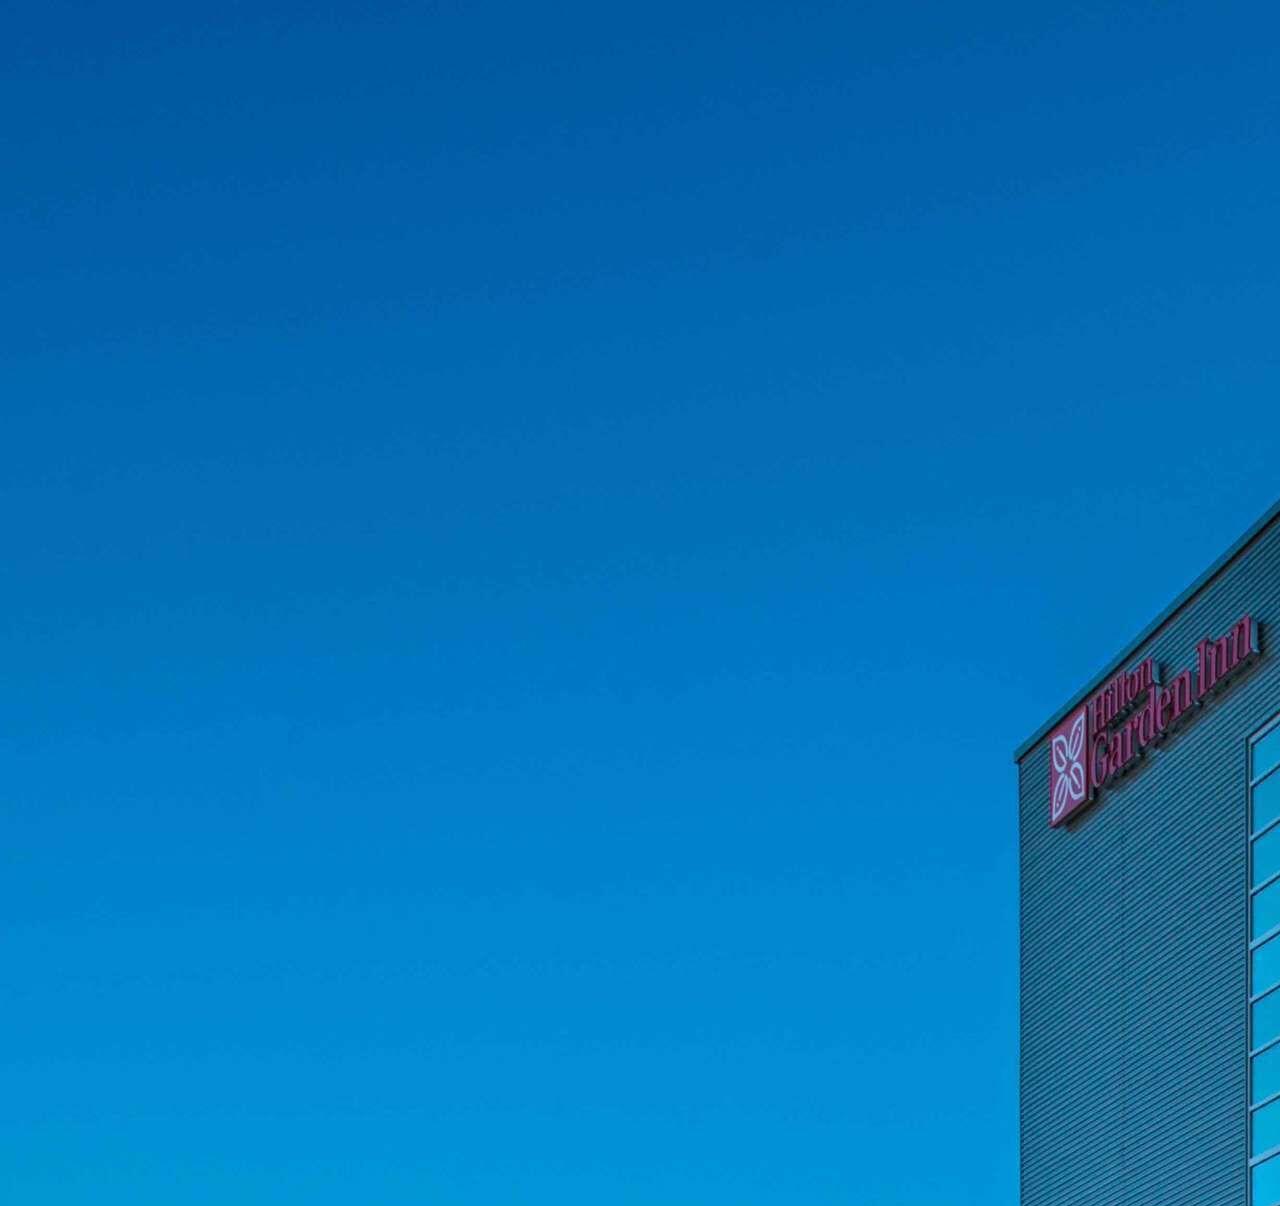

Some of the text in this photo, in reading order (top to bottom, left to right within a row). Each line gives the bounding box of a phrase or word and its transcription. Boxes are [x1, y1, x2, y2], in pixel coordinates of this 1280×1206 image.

[1090, 614, 1256, 789] Garden Inn
[1092, 657, 1156, 733] Hilton
